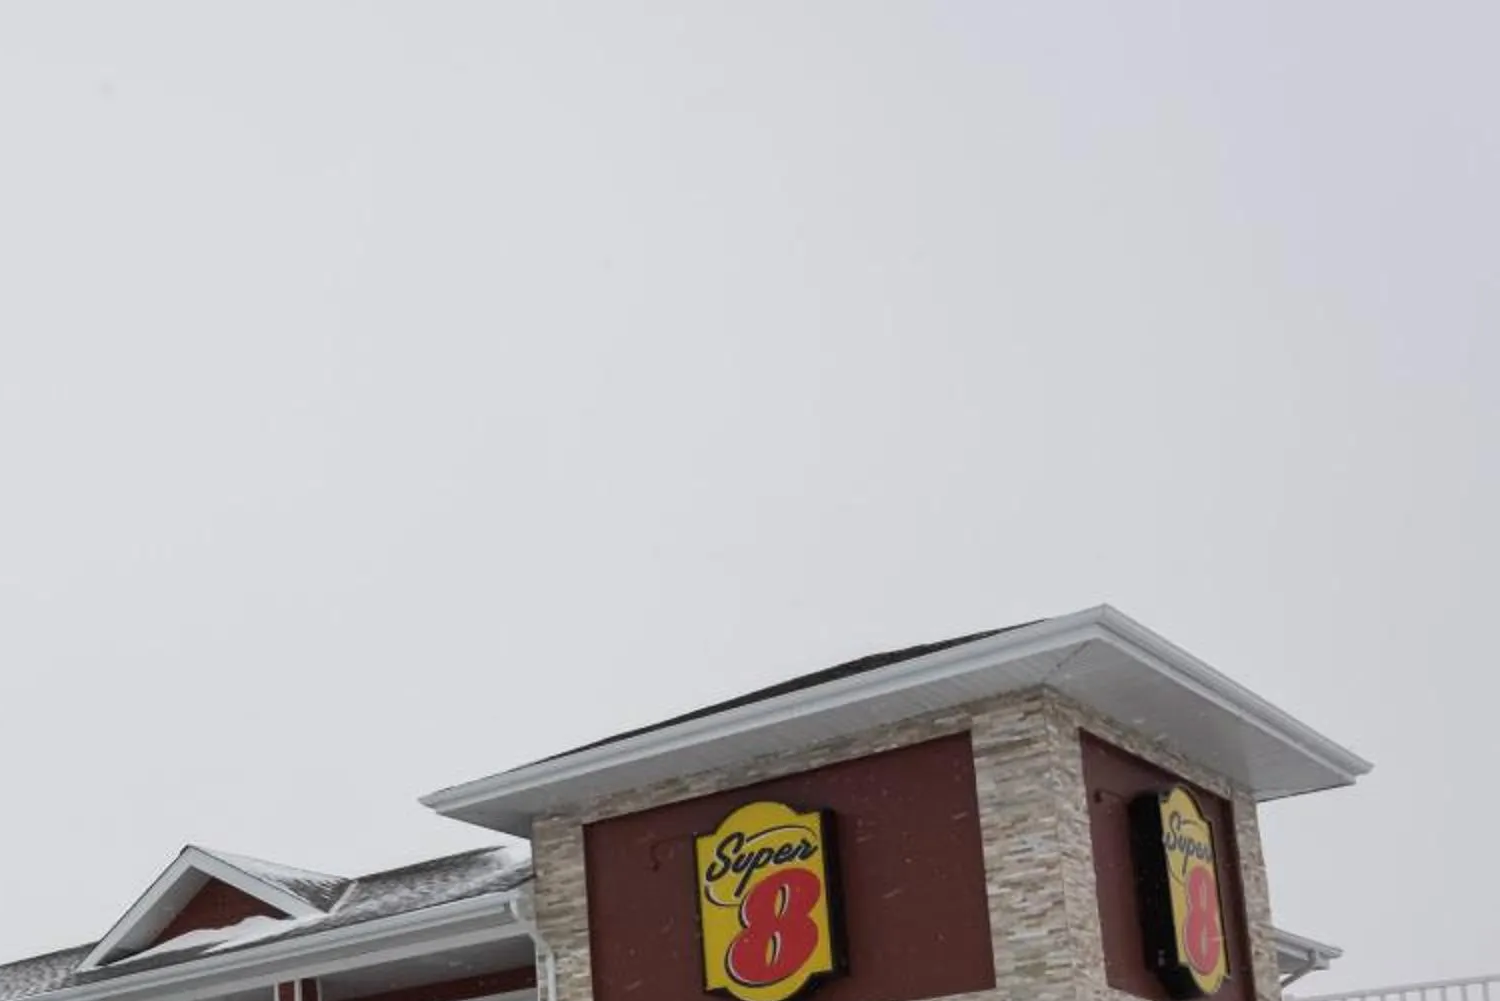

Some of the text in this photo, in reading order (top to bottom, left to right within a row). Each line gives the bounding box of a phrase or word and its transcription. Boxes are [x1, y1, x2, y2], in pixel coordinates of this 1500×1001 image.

[706, 832, 818, 897] Super
[1163, 811, 1214, 875] Super
[724, 867, 821, 988] 8
[1183, 864, 1220, 976] 8
